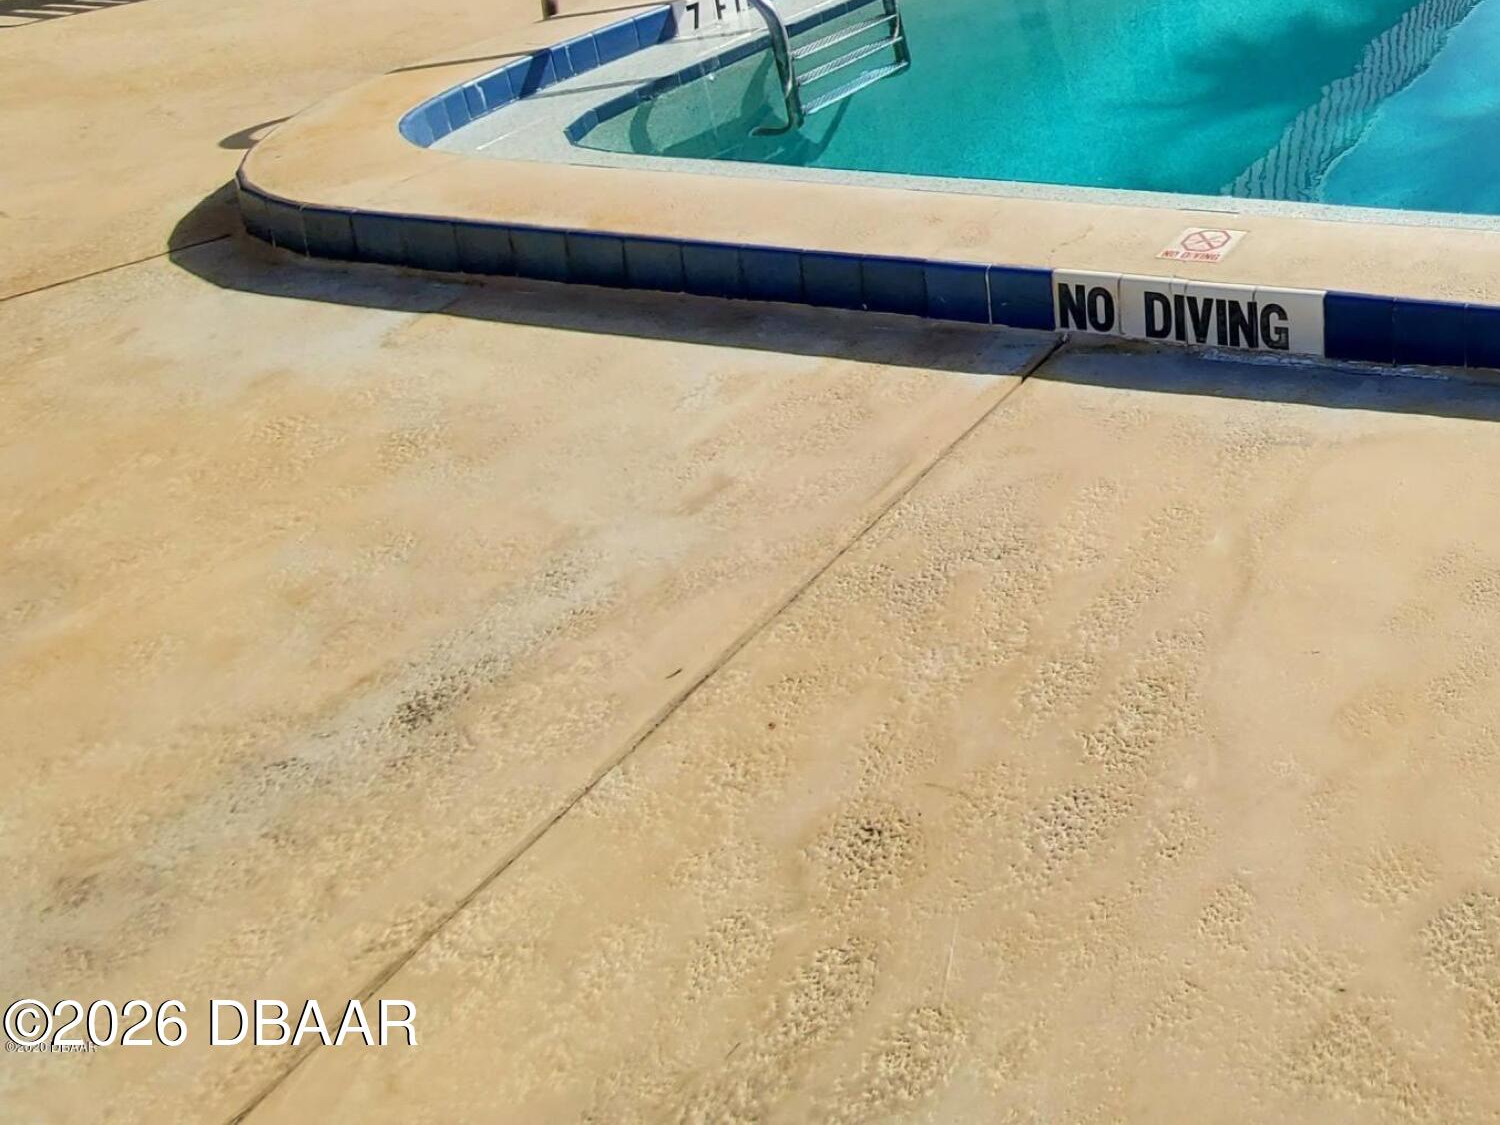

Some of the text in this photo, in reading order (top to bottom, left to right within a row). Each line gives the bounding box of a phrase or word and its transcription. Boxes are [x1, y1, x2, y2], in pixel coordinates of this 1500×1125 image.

[685, 2, 699, 31] 7
[1057, 282, 1290, 351] NO DIVING
